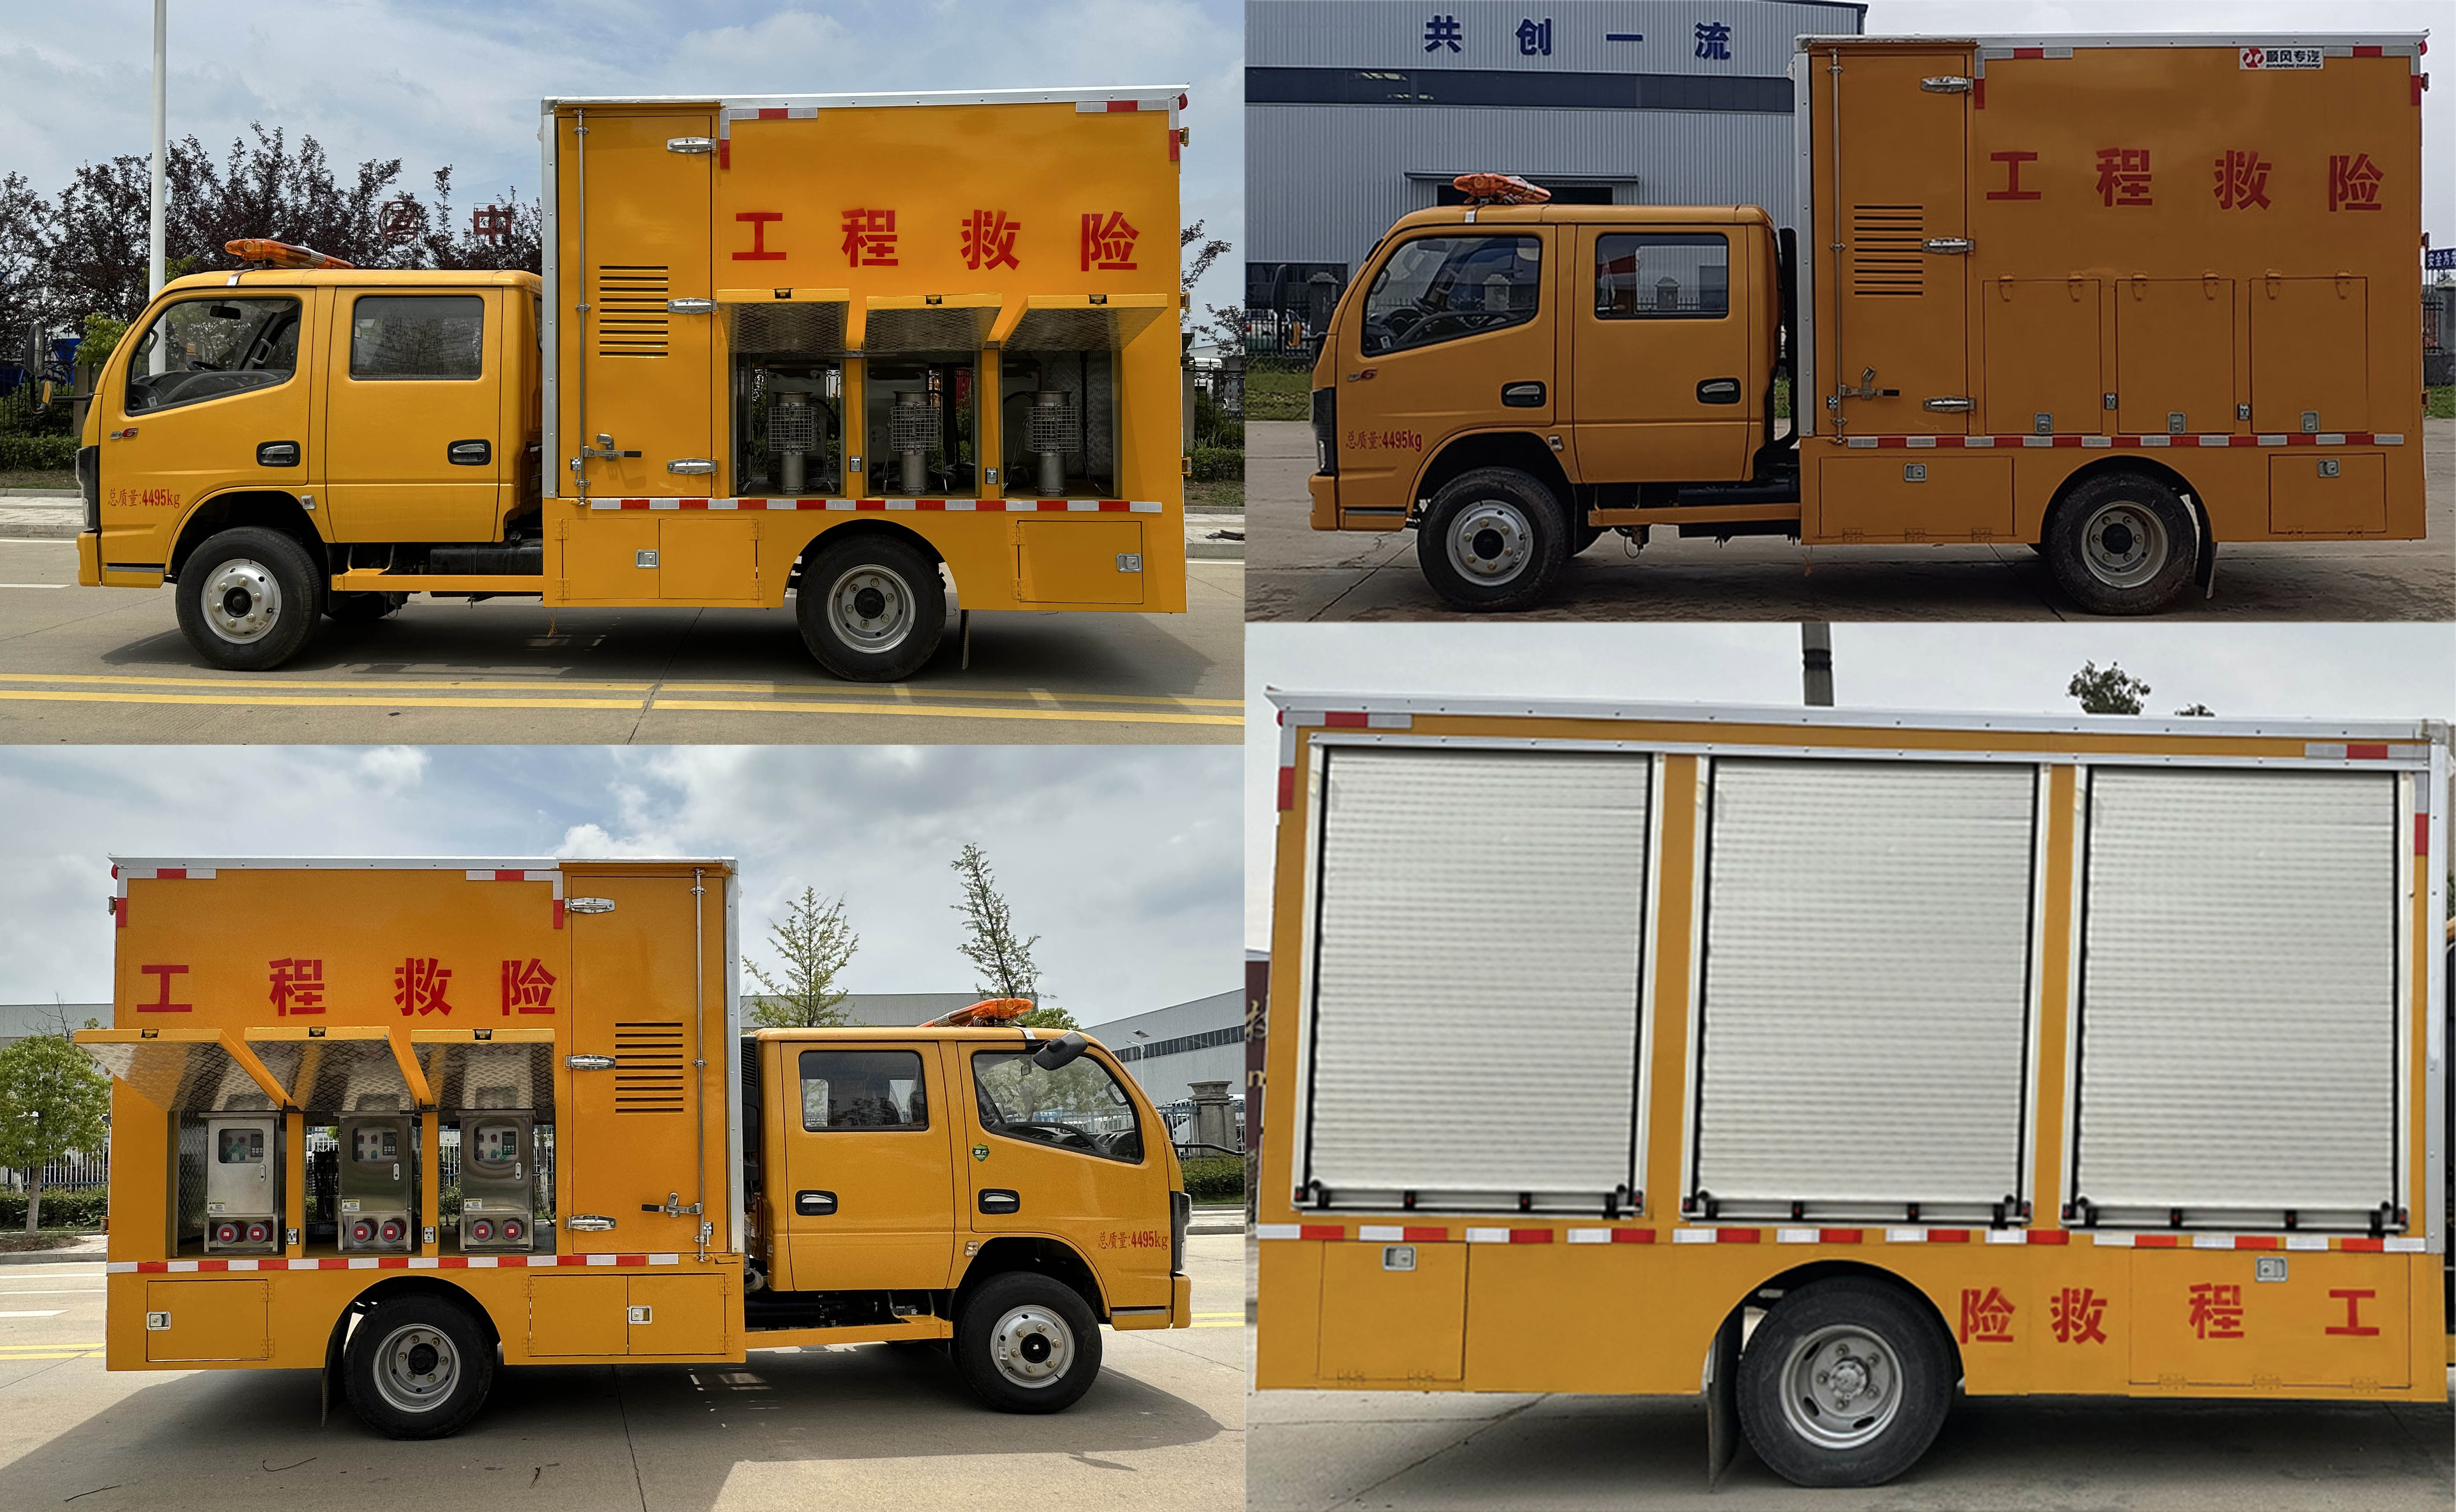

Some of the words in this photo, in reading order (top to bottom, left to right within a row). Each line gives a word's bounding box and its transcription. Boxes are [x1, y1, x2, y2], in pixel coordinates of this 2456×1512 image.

[1424, 15, 1731, 60] 共创一流
[2266, 50, 2319, 63] 顺风专汽
[1987, 148, 2384, 212] 工程救险
[732, 208, 1140, 272] 工程救险
[1346, 429, 1422, 452] 总质量:4495kg
[108, 488, 180, 508] 总质量:4495kg
[137, 957, 556, 1016] 工程救险
[1098, 1230, 1168, 1250] 总质量:4495kg
